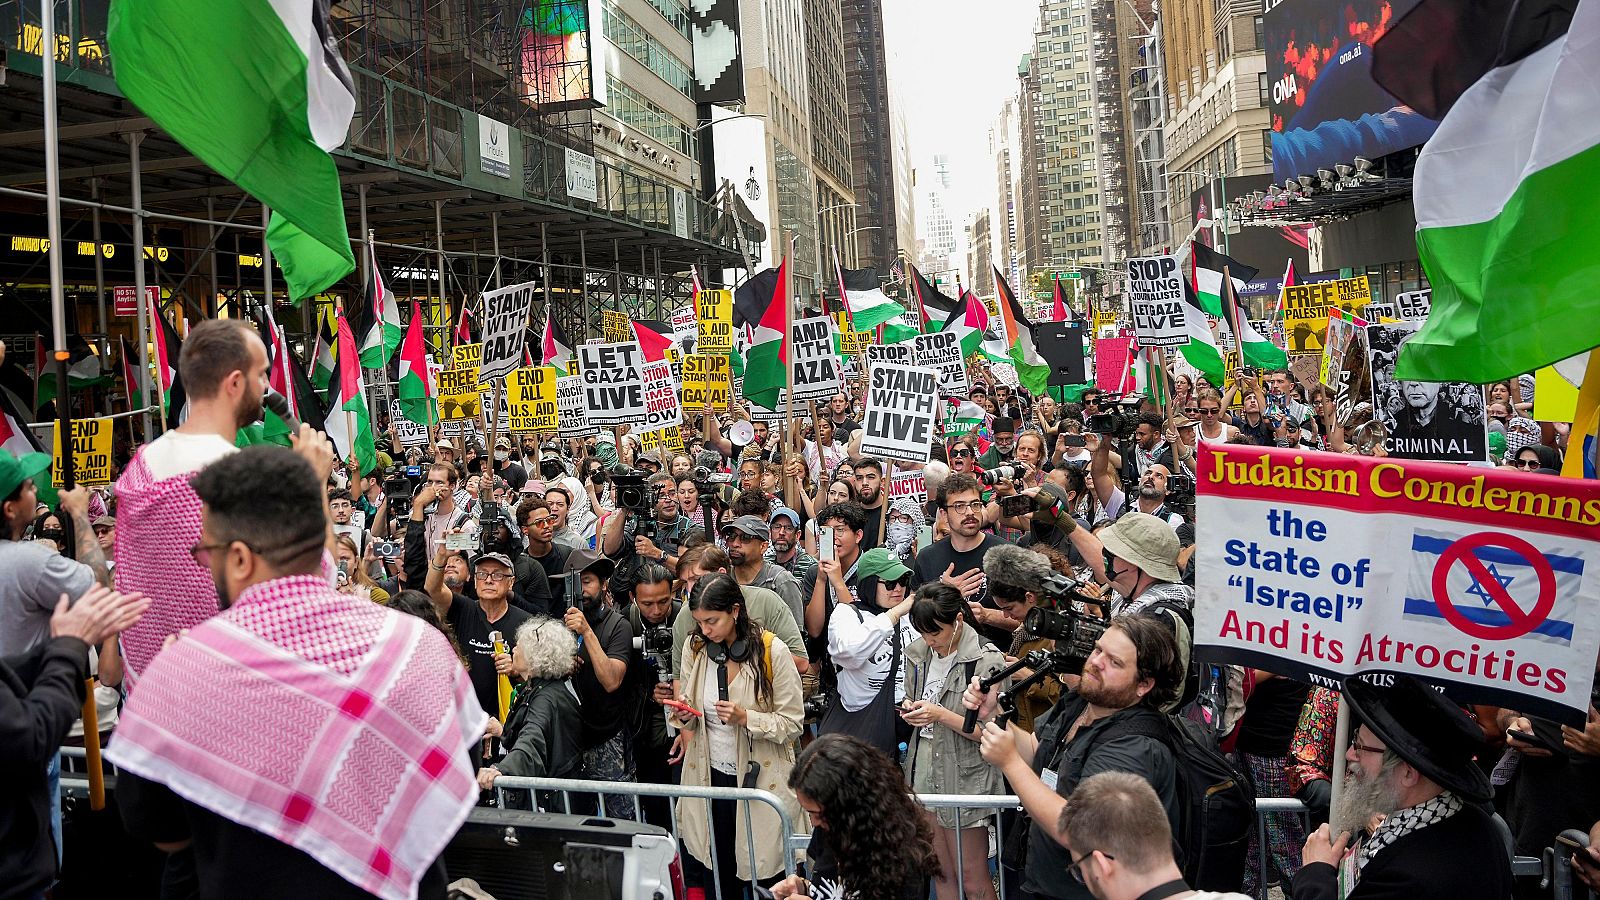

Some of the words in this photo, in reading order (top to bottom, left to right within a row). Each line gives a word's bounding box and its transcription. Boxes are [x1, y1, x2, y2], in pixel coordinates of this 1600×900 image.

[1339, 43, 1362, 65] ona.ai
[1273, 74, 1297, 104] ONA
[1129, 258, 1176, 280] STOP
[1131, 278, 1180, 292] KILLING
[1337, 277, 1366, 294] FREE
[117, 296, 136, 304] Anytim
[488, 288, 530, 318] STAND
[1286, 284, 1335, 308] FREE
[1134, 304, 1149, 315] LET
[1149, 302, 1184, 316] GAZA
[1365, 307, 1392, 321] STOP
[1402, 307, 1429, 318] GAZ
[487, 307, 527, 336] WITH
[710, 323, 729, 336] AID
[1135, 314, 1186, 329] LIVE
[793, 321, 829, 344] AND
[483, 329, 522, 365] GAZA
[793, 339, 831, 359] ITH
[915, 332, 956, 351] STOP
[455, 345, 482, 361] STO
[582, 345, 637, 369] LET
[868, 346, 908, 360] STOP
[916, 347, 959, 360] KILLING
[917, 355, 960, 366] JOURNALISTS
[685, 356, 726, 372] STOP
[793, 358, 836, 386] AZA
[439, 369, 475, 388] FREE
[517, 369, 545, 386] END
[583, 366, 640, 384] GAZA
[872, 367, 936, 395] STAND
[940, 372, 965, 384] VE
[438, 383, 478, 396] PALESTINE
[520, 385, 544, 401] ALL
[556, 386, 583, 399] ENOCID
[586, 385, 644, 411] LIVE
[510, 404, 533, 418] U.S.
[535, 402, 555, 416] AID
[872, 389, 934, 414] WITH
[557, 407, 587, 418] FRE
[510, 418, 521, 428] TO
[523, 416, 556, 428] ISRAEL!
[866, 411, 930, 444] LIVE
[665, 426, 679, 438] AID
[1386, 437, 1474, 454] CRIMINAL
[86, 454, 107, 470] AID
[1208, 451, 1359, 497] Judaism
[1369, 463, 1600, 526] Condemns
[1266, 508, 1327, 542] the
[1223, 539, 1320, 578] State
[1331, 558, 1371, 588] of
[1228, 574, 1363, 623] “Israel”
[1219, 609, 1290, 650] And
[1300, 622, 1344, 664] its
[1355, 632, 1569, 695] Atrocities
